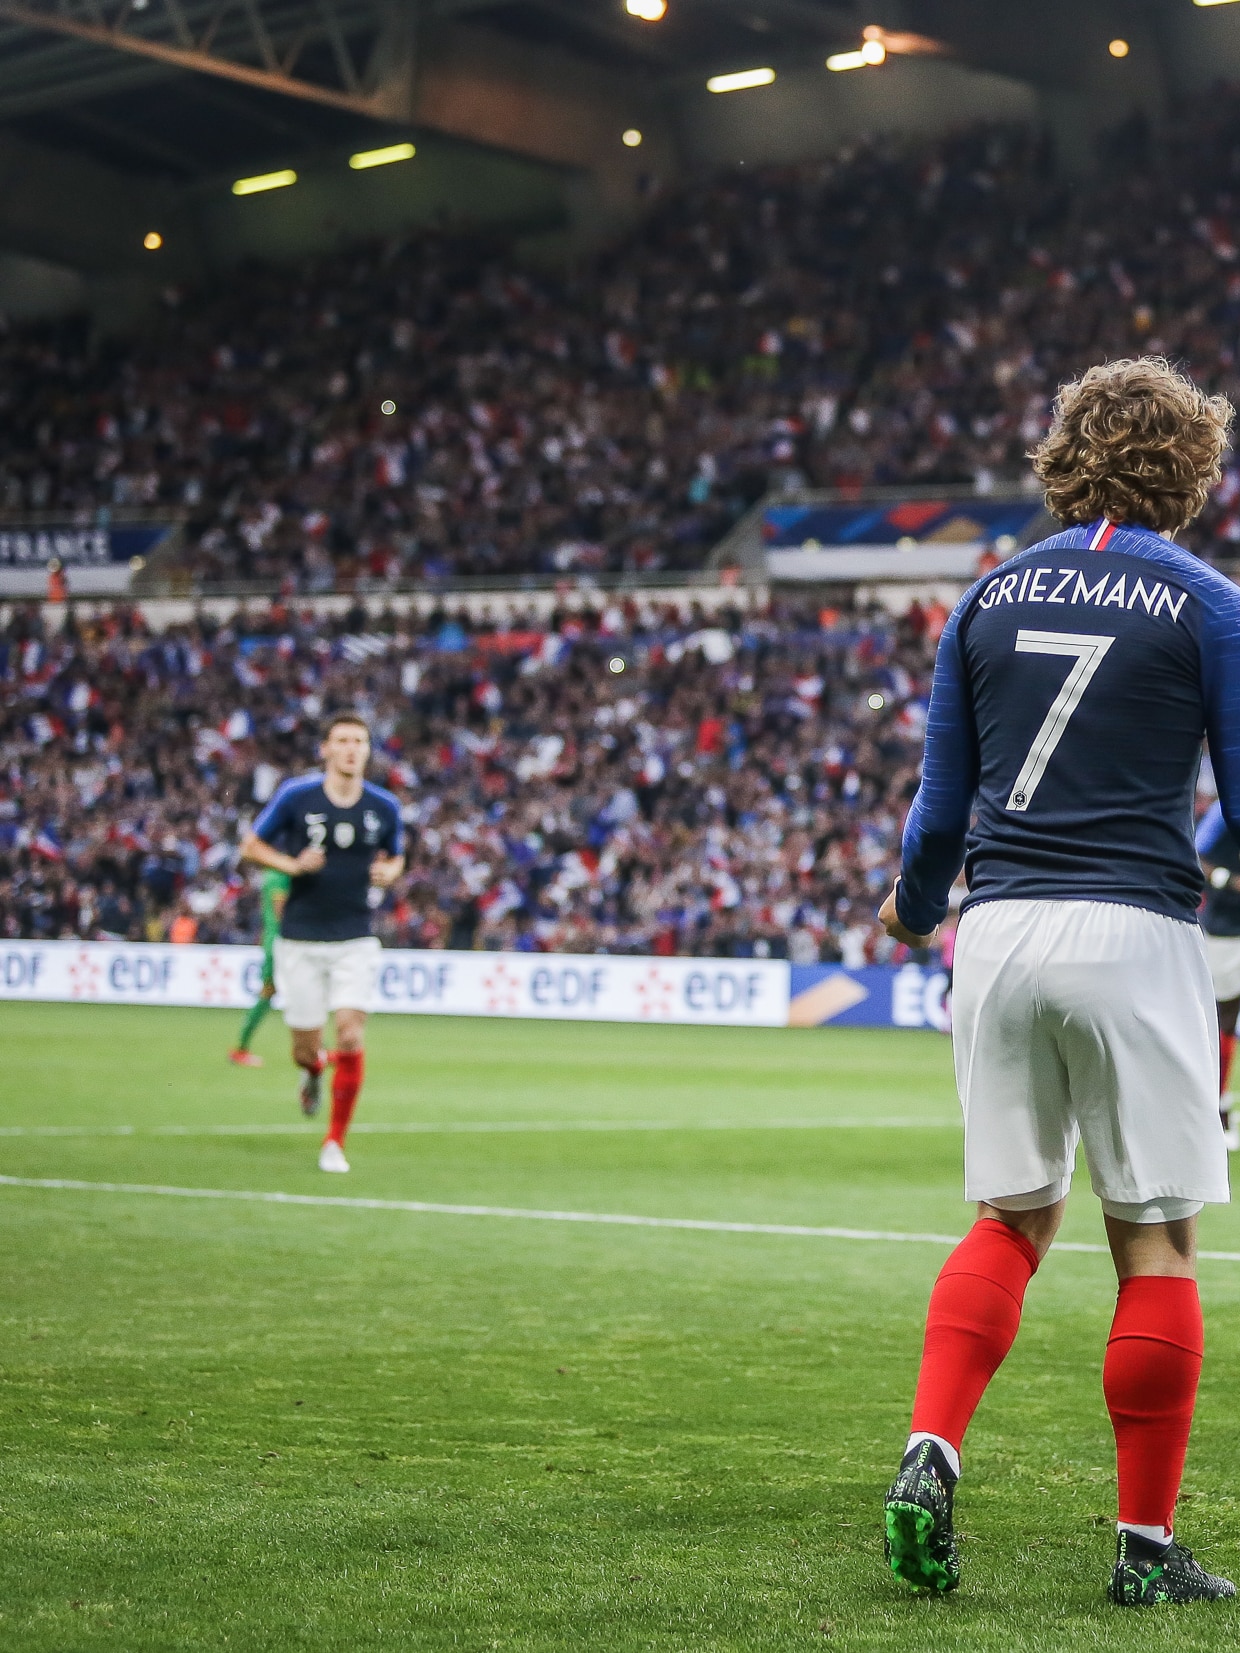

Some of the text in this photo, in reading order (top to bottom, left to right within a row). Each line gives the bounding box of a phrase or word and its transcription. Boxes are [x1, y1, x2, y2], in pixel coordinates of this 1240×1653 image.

[978, 568, 1189, 624] GRIEZMANN
[1005, 629, 1117, 812] 7
[0, 952, 43, 989] DF
